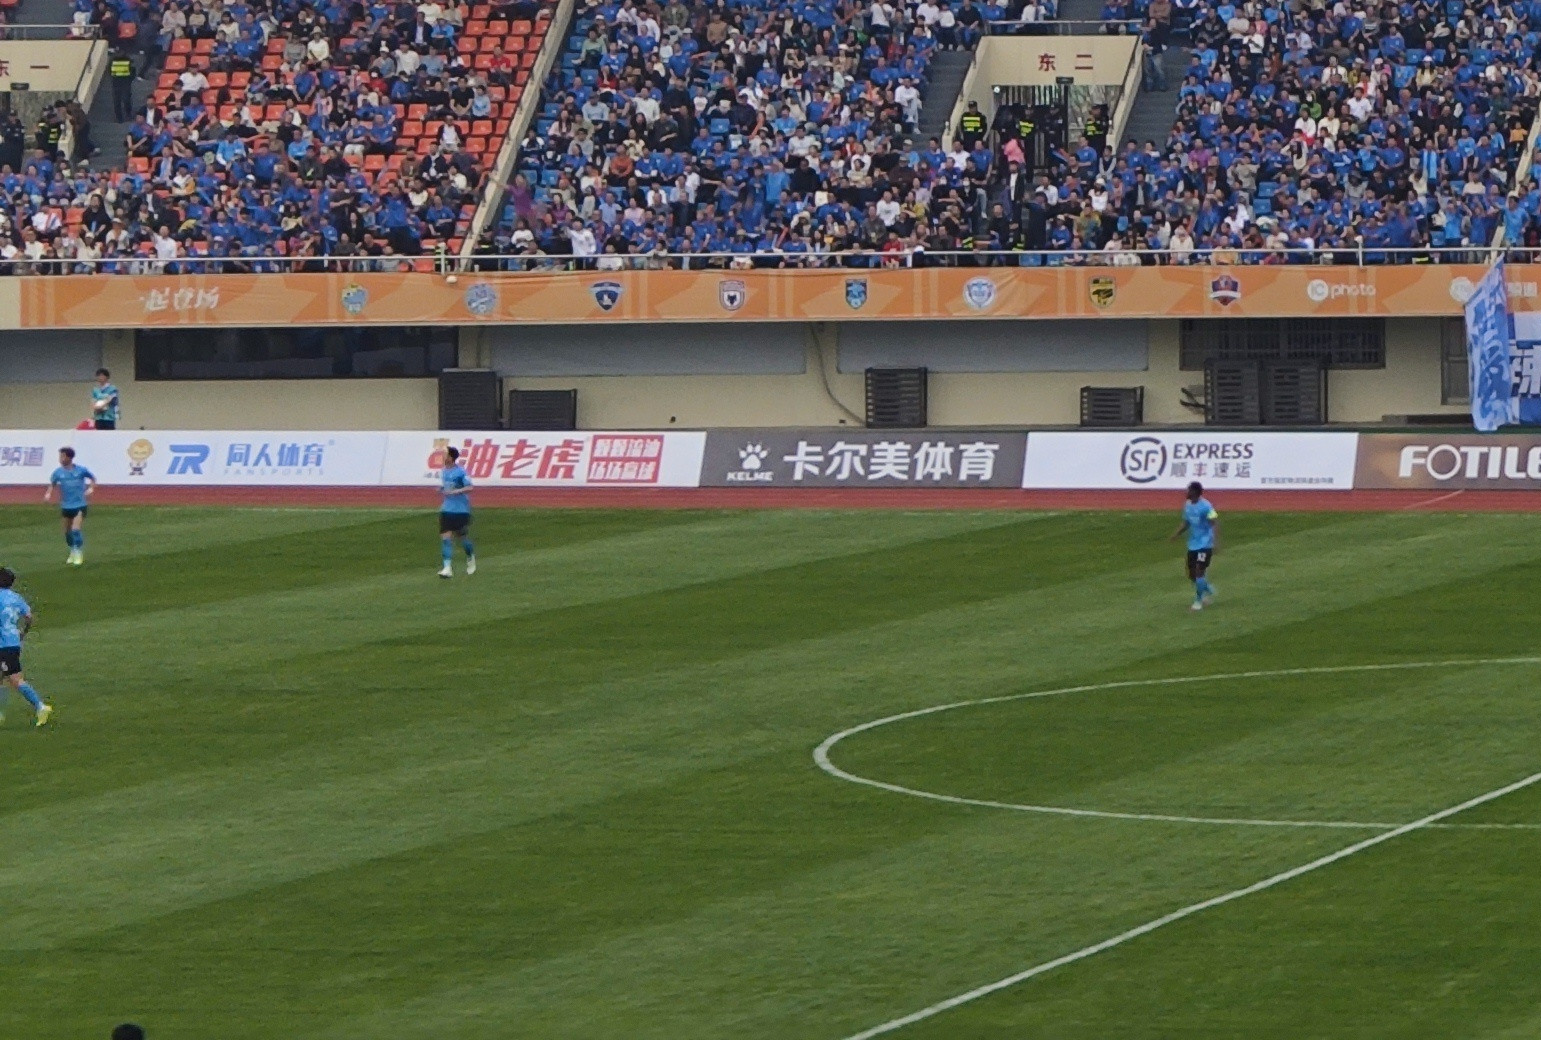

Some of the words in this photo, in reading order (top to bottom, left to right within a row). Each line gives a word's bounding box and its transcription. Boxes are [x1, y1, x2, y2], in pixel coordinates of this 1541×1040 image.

[1038, 53, 1094, 72] 东二
[225, 442, 325, 468] 同人体育
[782, 440, 1000, 482] 卡尔美体育
[1173, 443, 1254, 460] EXPRESS
[726, 471, 775, 482] KELME
